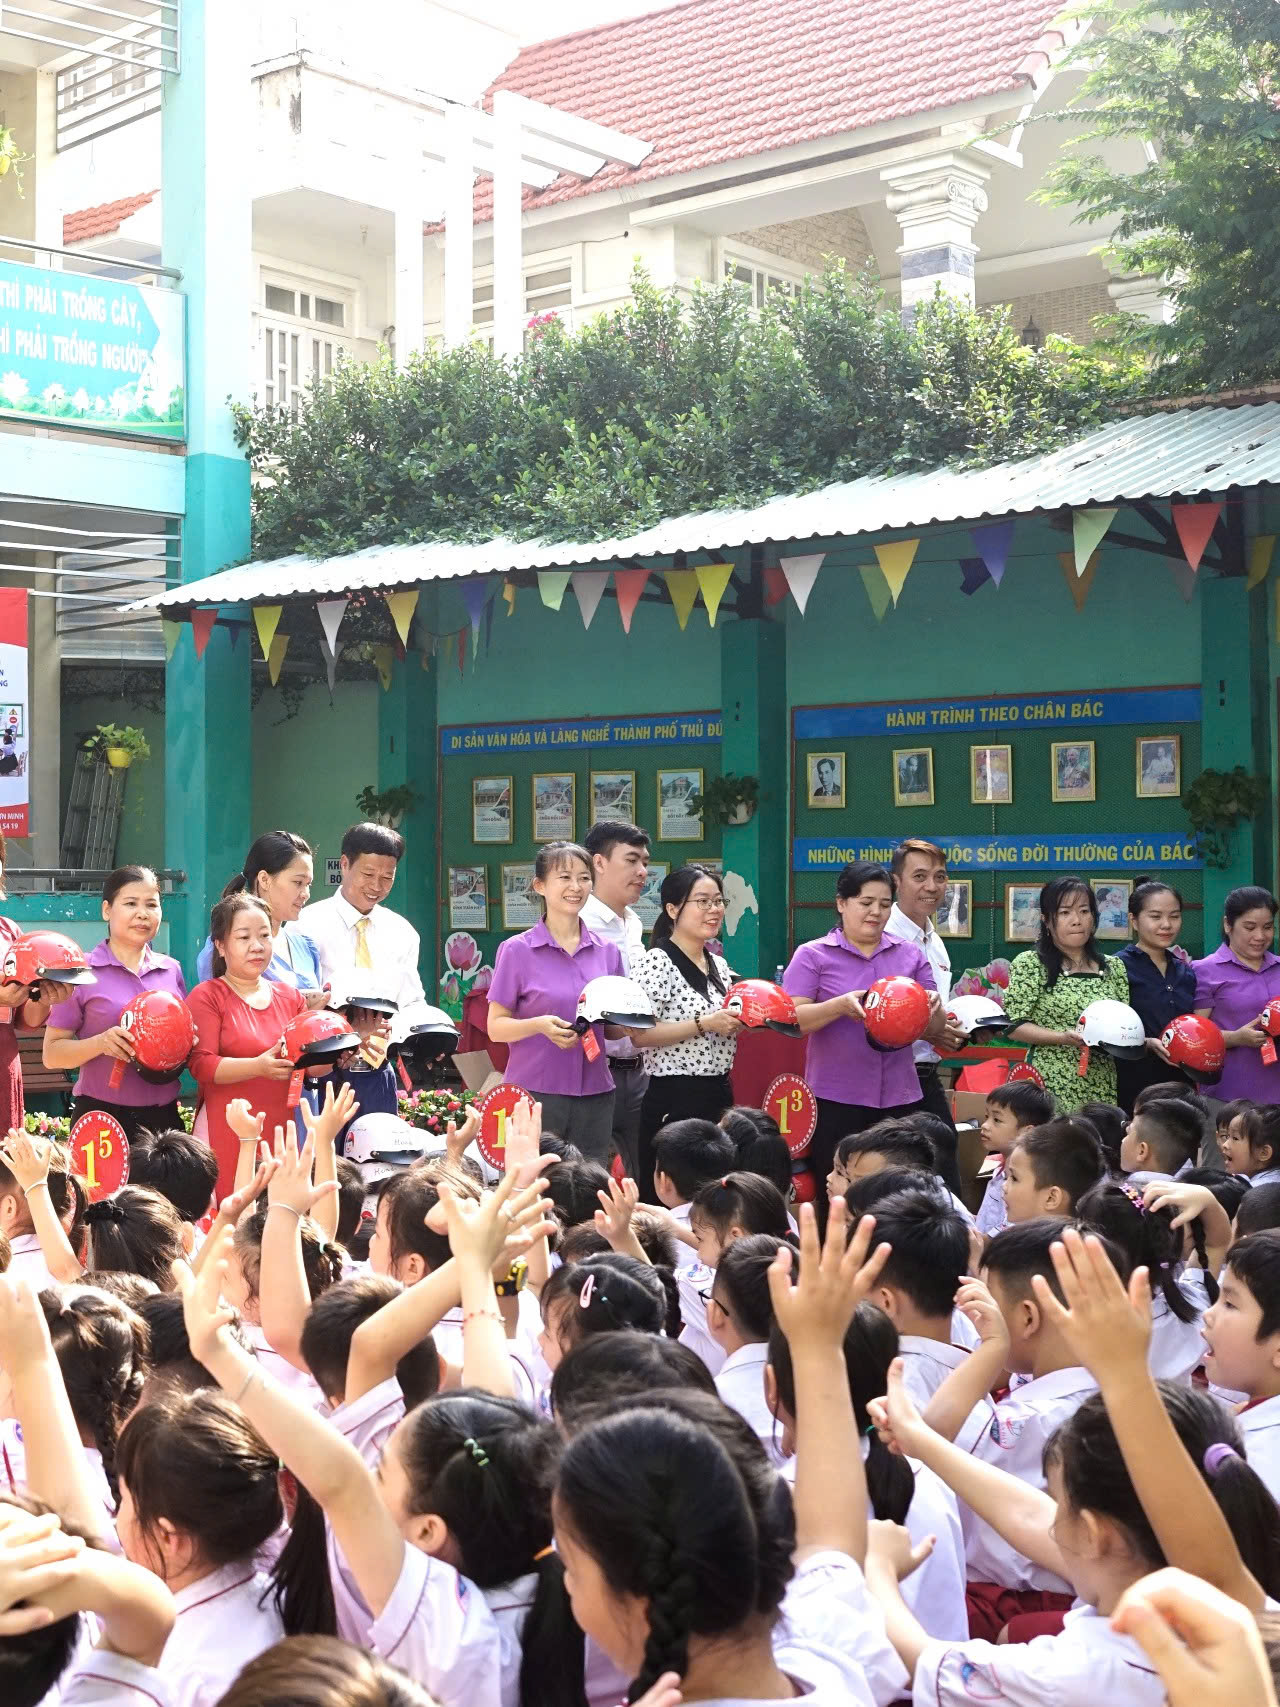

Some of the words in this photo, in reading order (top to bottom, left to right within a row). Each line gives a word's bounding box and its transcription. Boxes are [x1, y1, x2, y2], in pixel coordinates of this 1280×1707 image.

[886, 708, 926, 727] HÀNH
[930, 705, 974, 725] TRÌNH
[980, 706, 1019, 722] THEO
[1024, 700, 1065, 720] CHÂN
[1071, 699, 1103, 718] BÁC
[451, 736, 461, 748] DI
[464, 730, 484, 748] SẢN
[487, 732, 507, 746] VĂN
[510, 729, 531, 745] HÓA
[534, 728, 547, 744] VÀ
[551, 727, 578, 744] LÀNG
[614, 724, 650, 740] THÀNH
[654, 720, 678, 738] PHỐ
[681, 719, 703, 737] THỦ
[327, 860, 342, 870] KH
[808, 845, 855, 863] NHỮNG
[859, 845, 893, 863] HÌNH
[942, 844, 972, 865] UỘC
[977, 842, 1017, 862] SỐNG
[1022, 843, 1049, 862] ĐỜI
[1054, 841, 1118, 862] THƯỜNG
[1122, 840, 1155, 861] CỦA
[1160, 841, 1195, 861] BÁC
